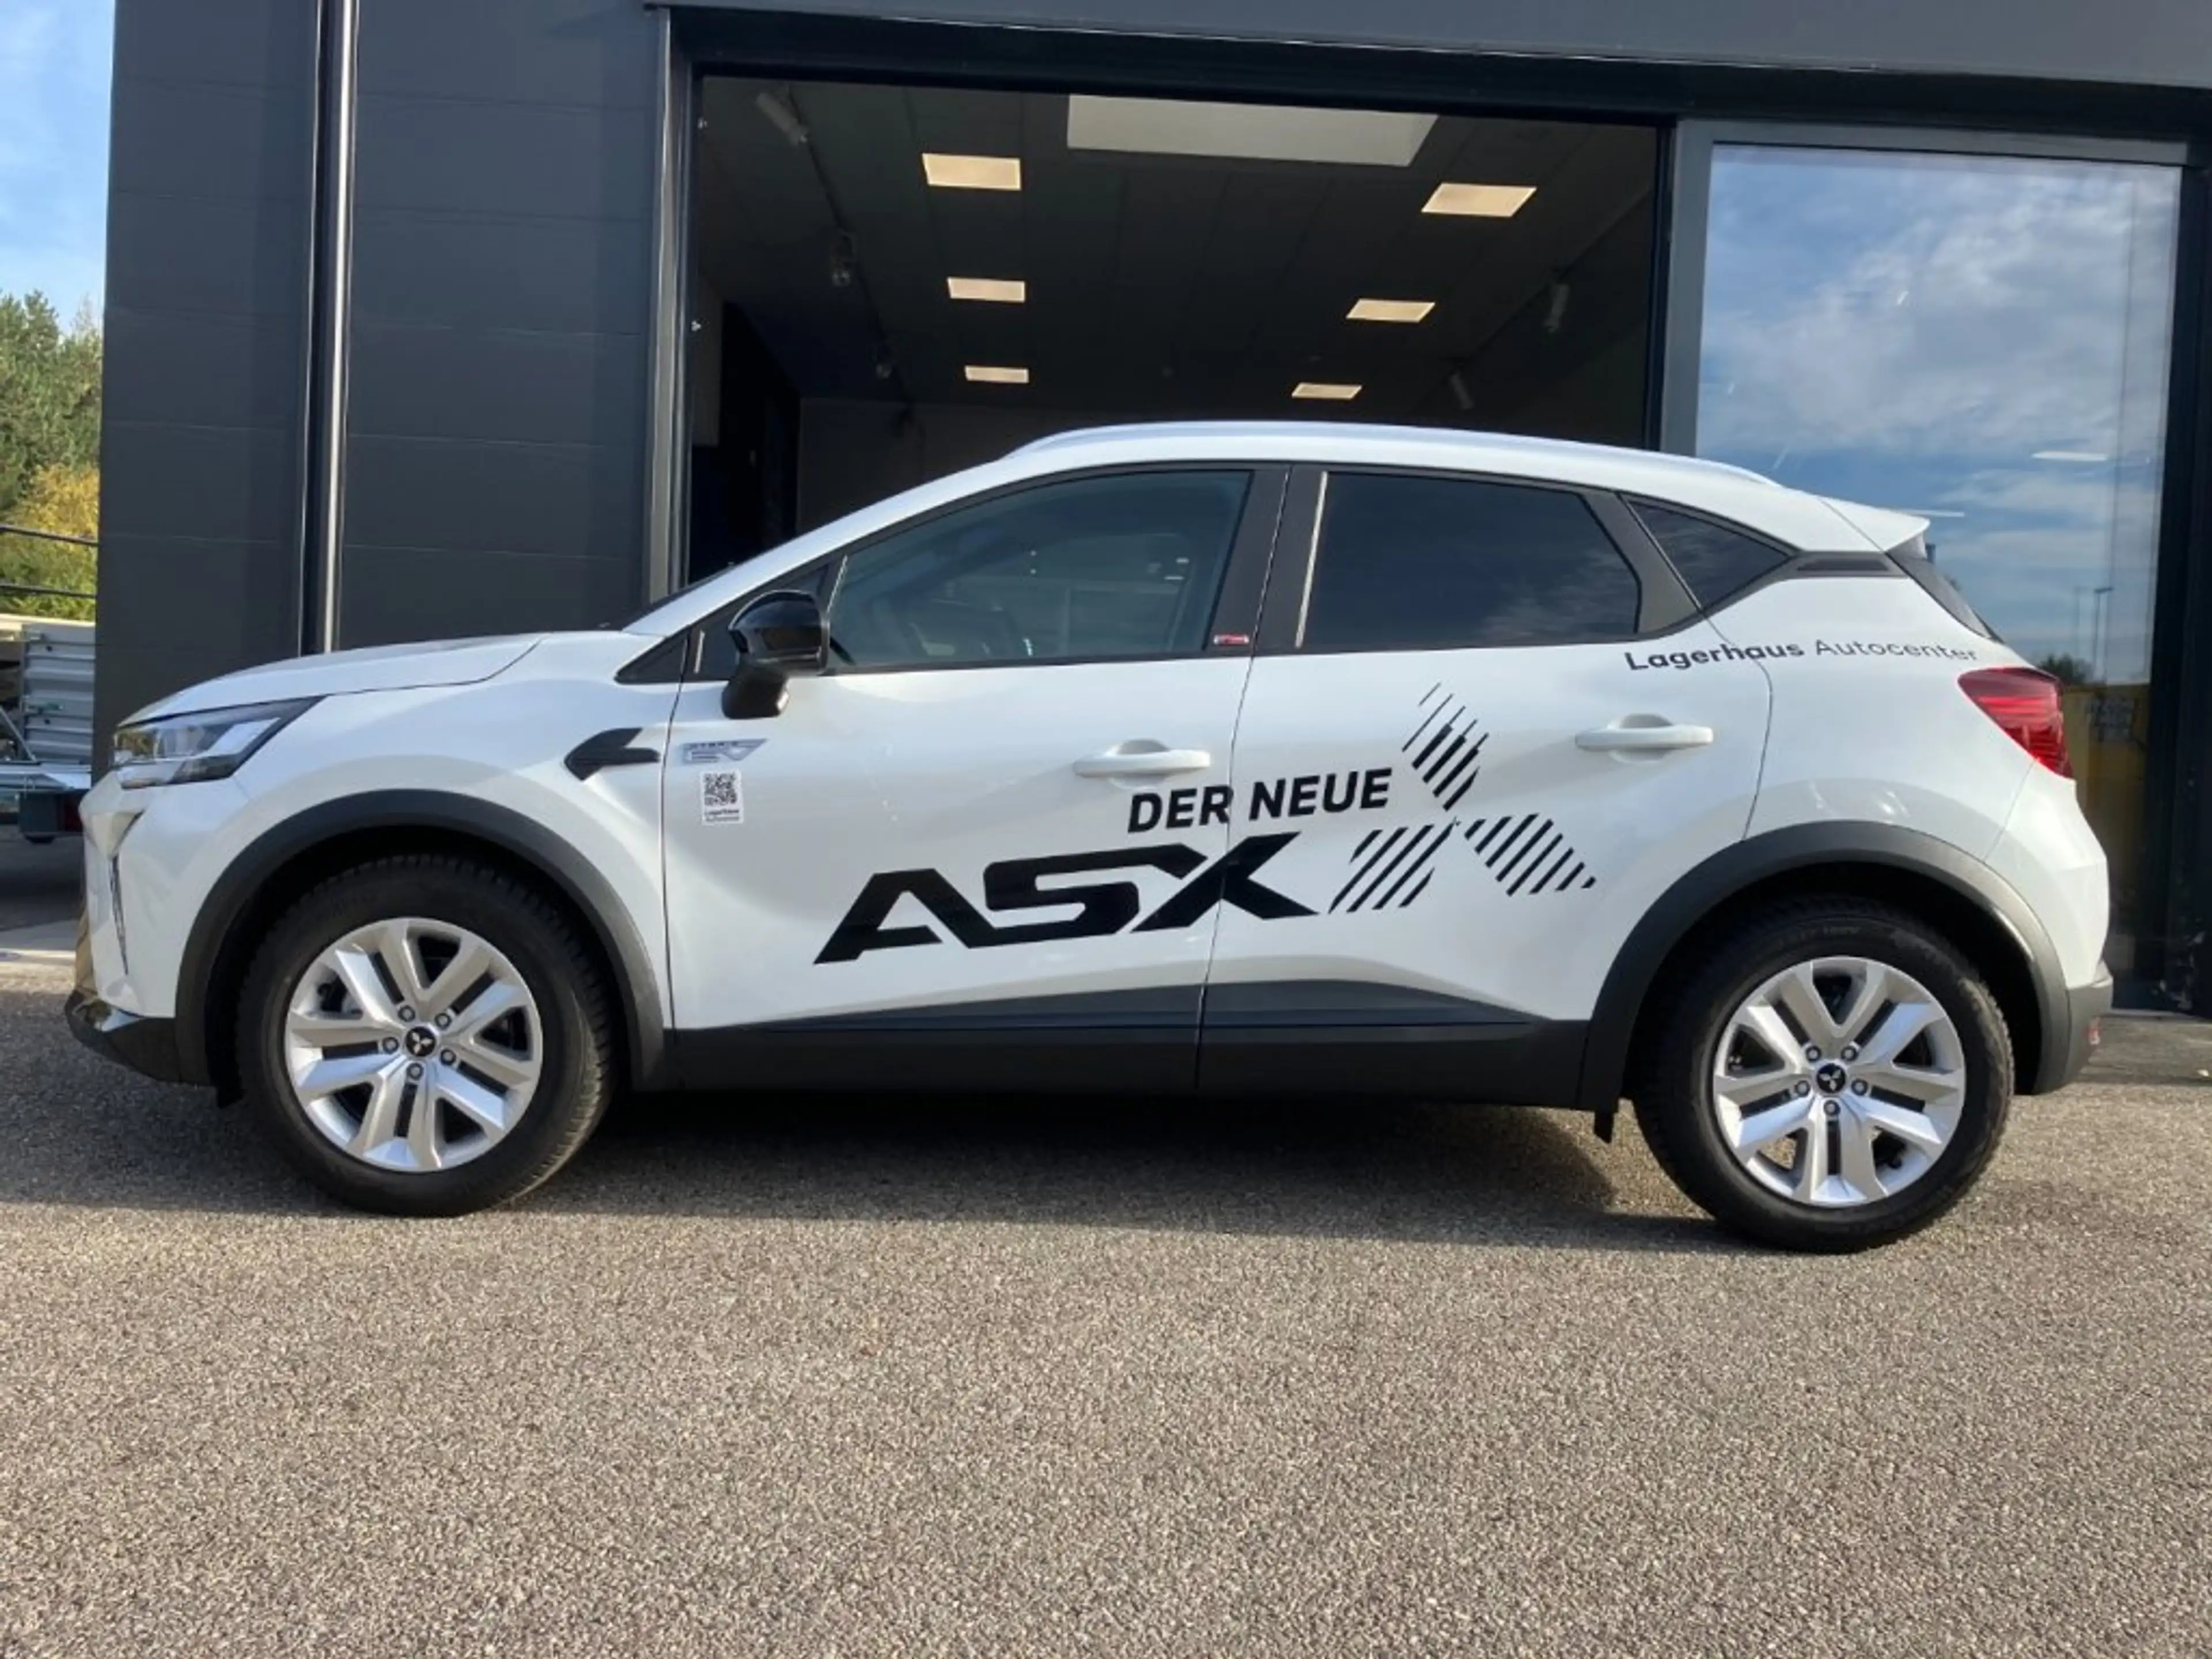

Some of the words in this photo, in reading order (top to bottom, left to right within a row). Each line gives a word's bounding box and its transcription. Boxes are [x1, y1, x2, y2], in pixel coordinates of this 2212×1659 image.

[1624, 643, 1805, 671] Lagerhaus
[1816, 639, 1978, 660] Autocenter
[1127, 784, 1234, 834] DER
[1248, 767, 1393, 821] NEUE
[813, 831, 1319, 965] ASX
